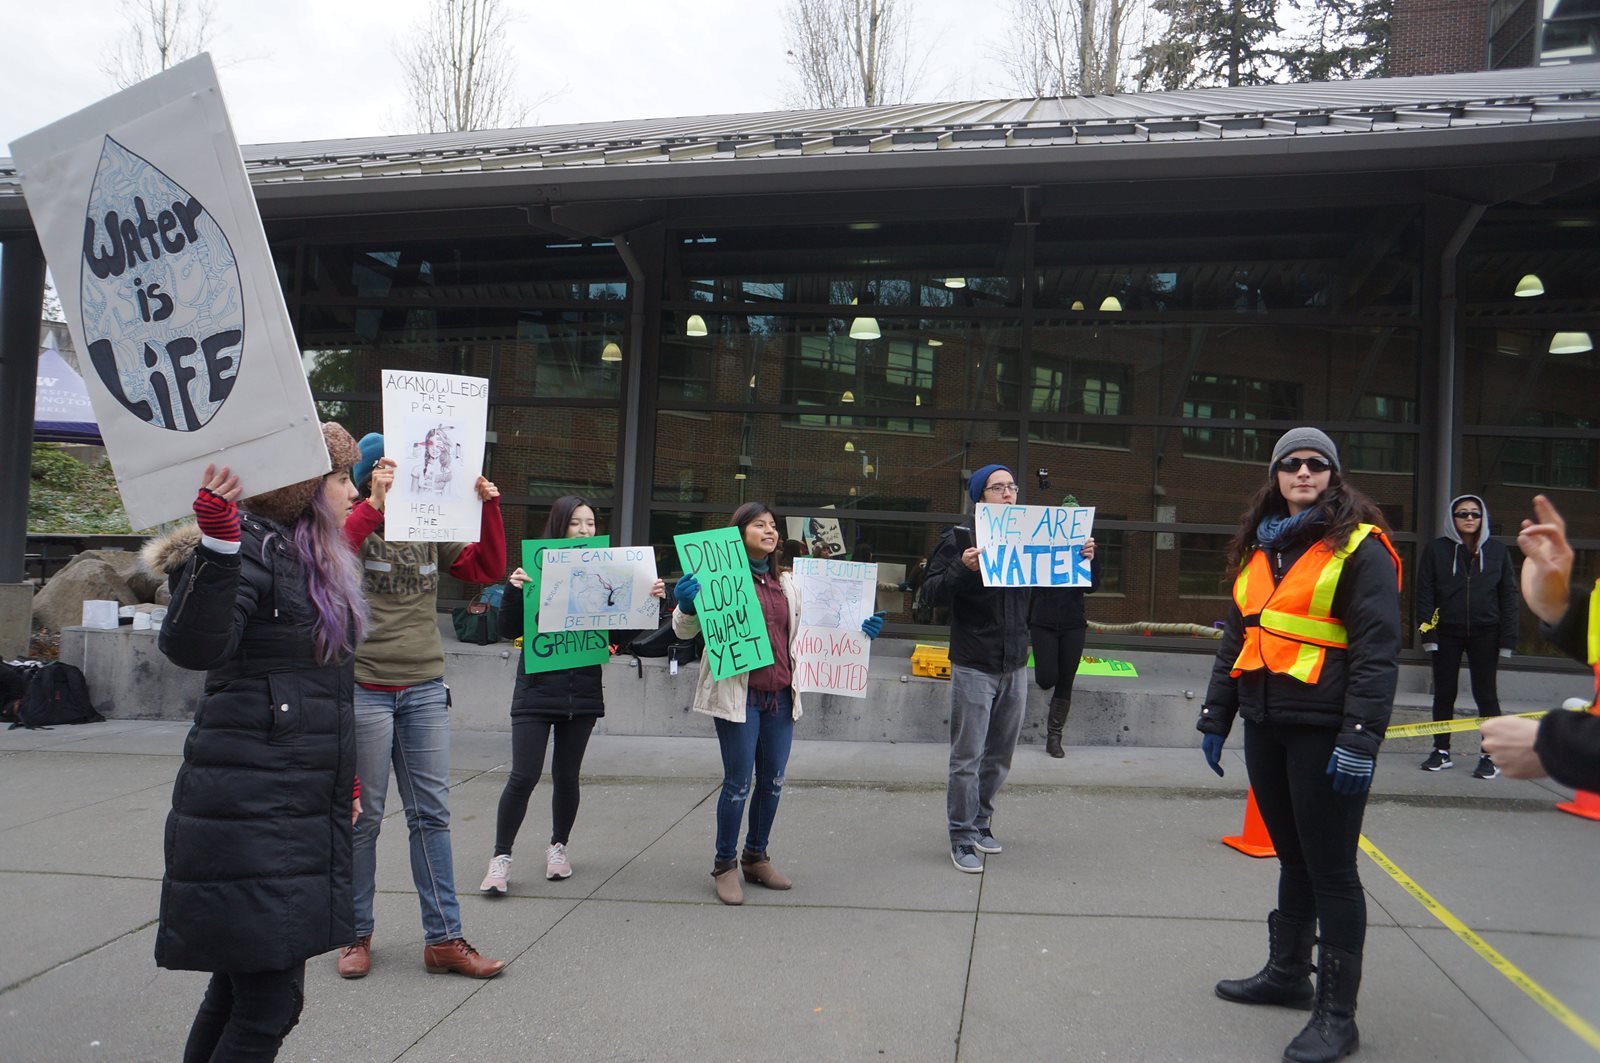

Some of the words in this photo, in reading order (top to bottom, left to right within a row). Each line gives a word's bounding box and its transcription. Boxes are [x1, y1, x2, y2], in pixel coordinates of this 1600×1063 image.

[136, 277, 174, 322] is
[411, 402, 455, 416] PAST
[419, 392, 446, 403] THE
[410, 503, 446, 516] HEAL
[416, 516, 438, 526] THE
[408, 527, 457, 540] PRESENT
[982, 506, 1026, 538] WE
[1031, 508, 1089, 540] ARE
[547, 551, 572, 563] WE
[581, 551, 613, 562] CAN
[626, 550, 643, 561] DO
[684, 539, 743, 575] DONT
[793, 558, 819, 577] THE
[825, 560, 878, 581] ROUTE
[980, 545, 1091, 585] WATER
[699, 575, 748, 612] LOOK
[564, 612, 628, 629] BETTER
[706, 604, 751, 647] AWAY
[532, 630, 607, 658] GRAVES
[711, 636, 761, 676] YET
[829, 632, 862, 657] WAS
[799, 661, 868, 691] ONSULTED
